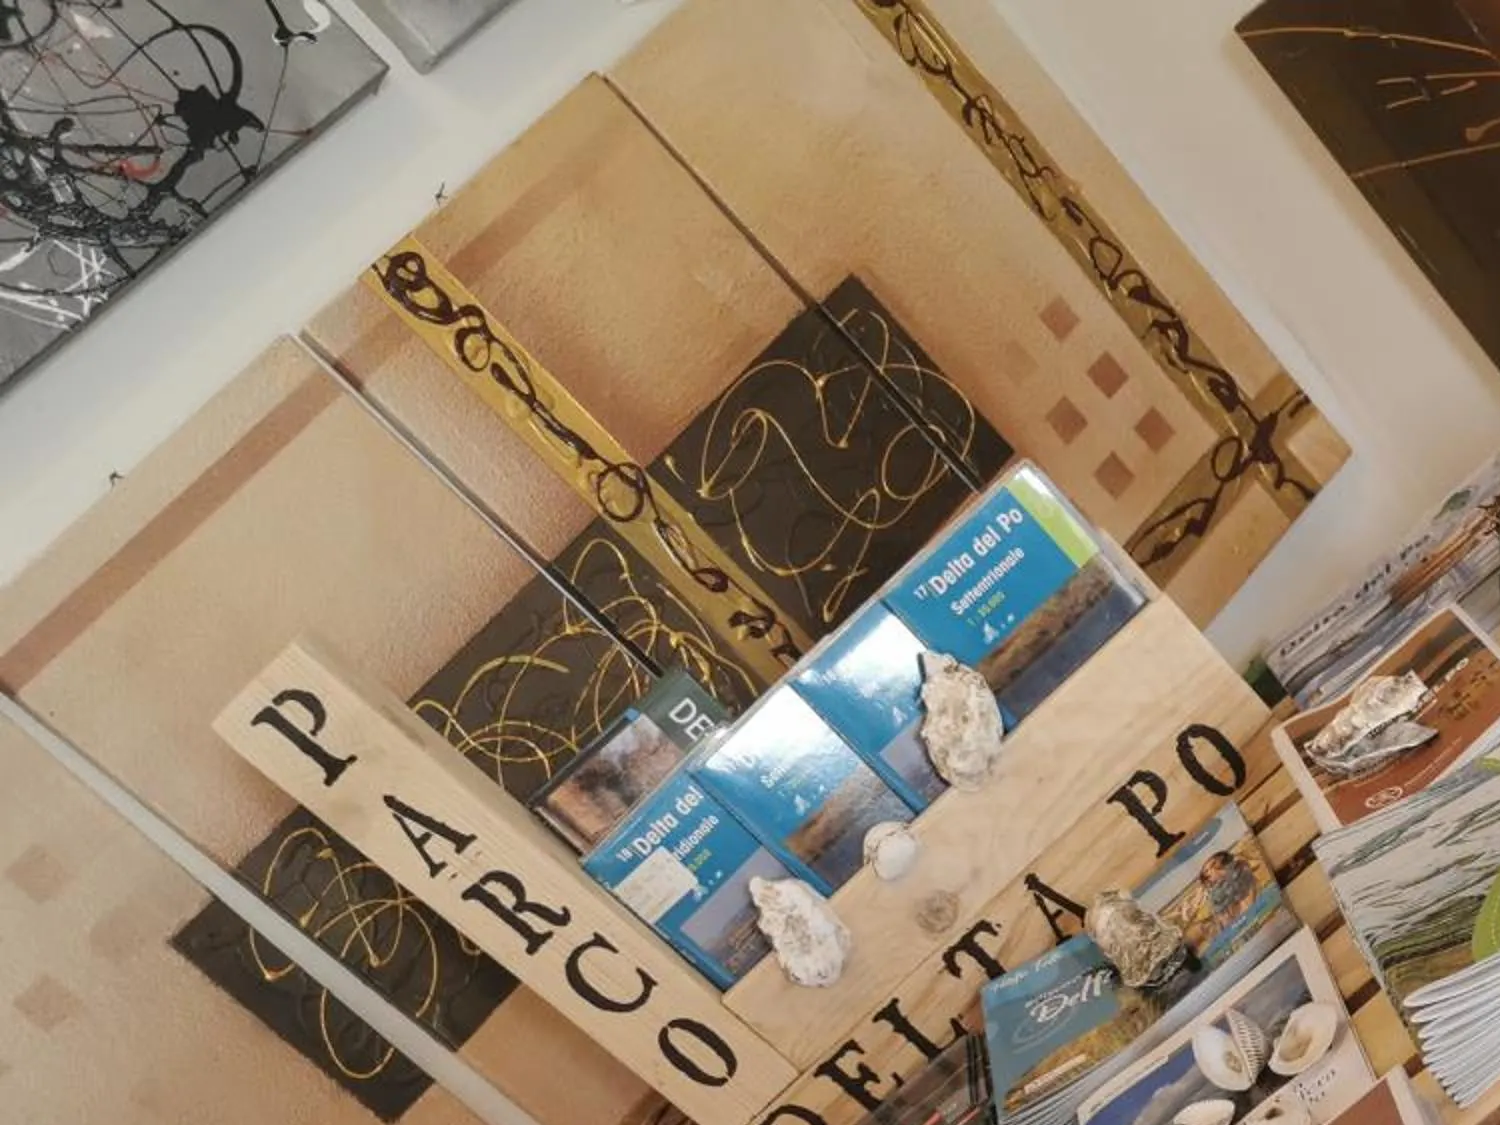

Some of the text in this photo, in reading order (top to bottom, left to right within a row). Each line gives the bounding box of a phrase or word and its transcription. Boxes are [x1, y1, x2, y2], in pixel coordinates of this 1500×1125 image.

[930, 551, 976, 597] Delta
[972, 524, 1002, 557] del
[996, 508, 1024, 533] Po
[951, 546, 1026, 616] Settentrionale
[633, 812, 680, 858] Delta
[675, 786, 706, 817] del
[1106, 722, 1247, 859] PO
[251, 688, 738, 1087] PARCO
